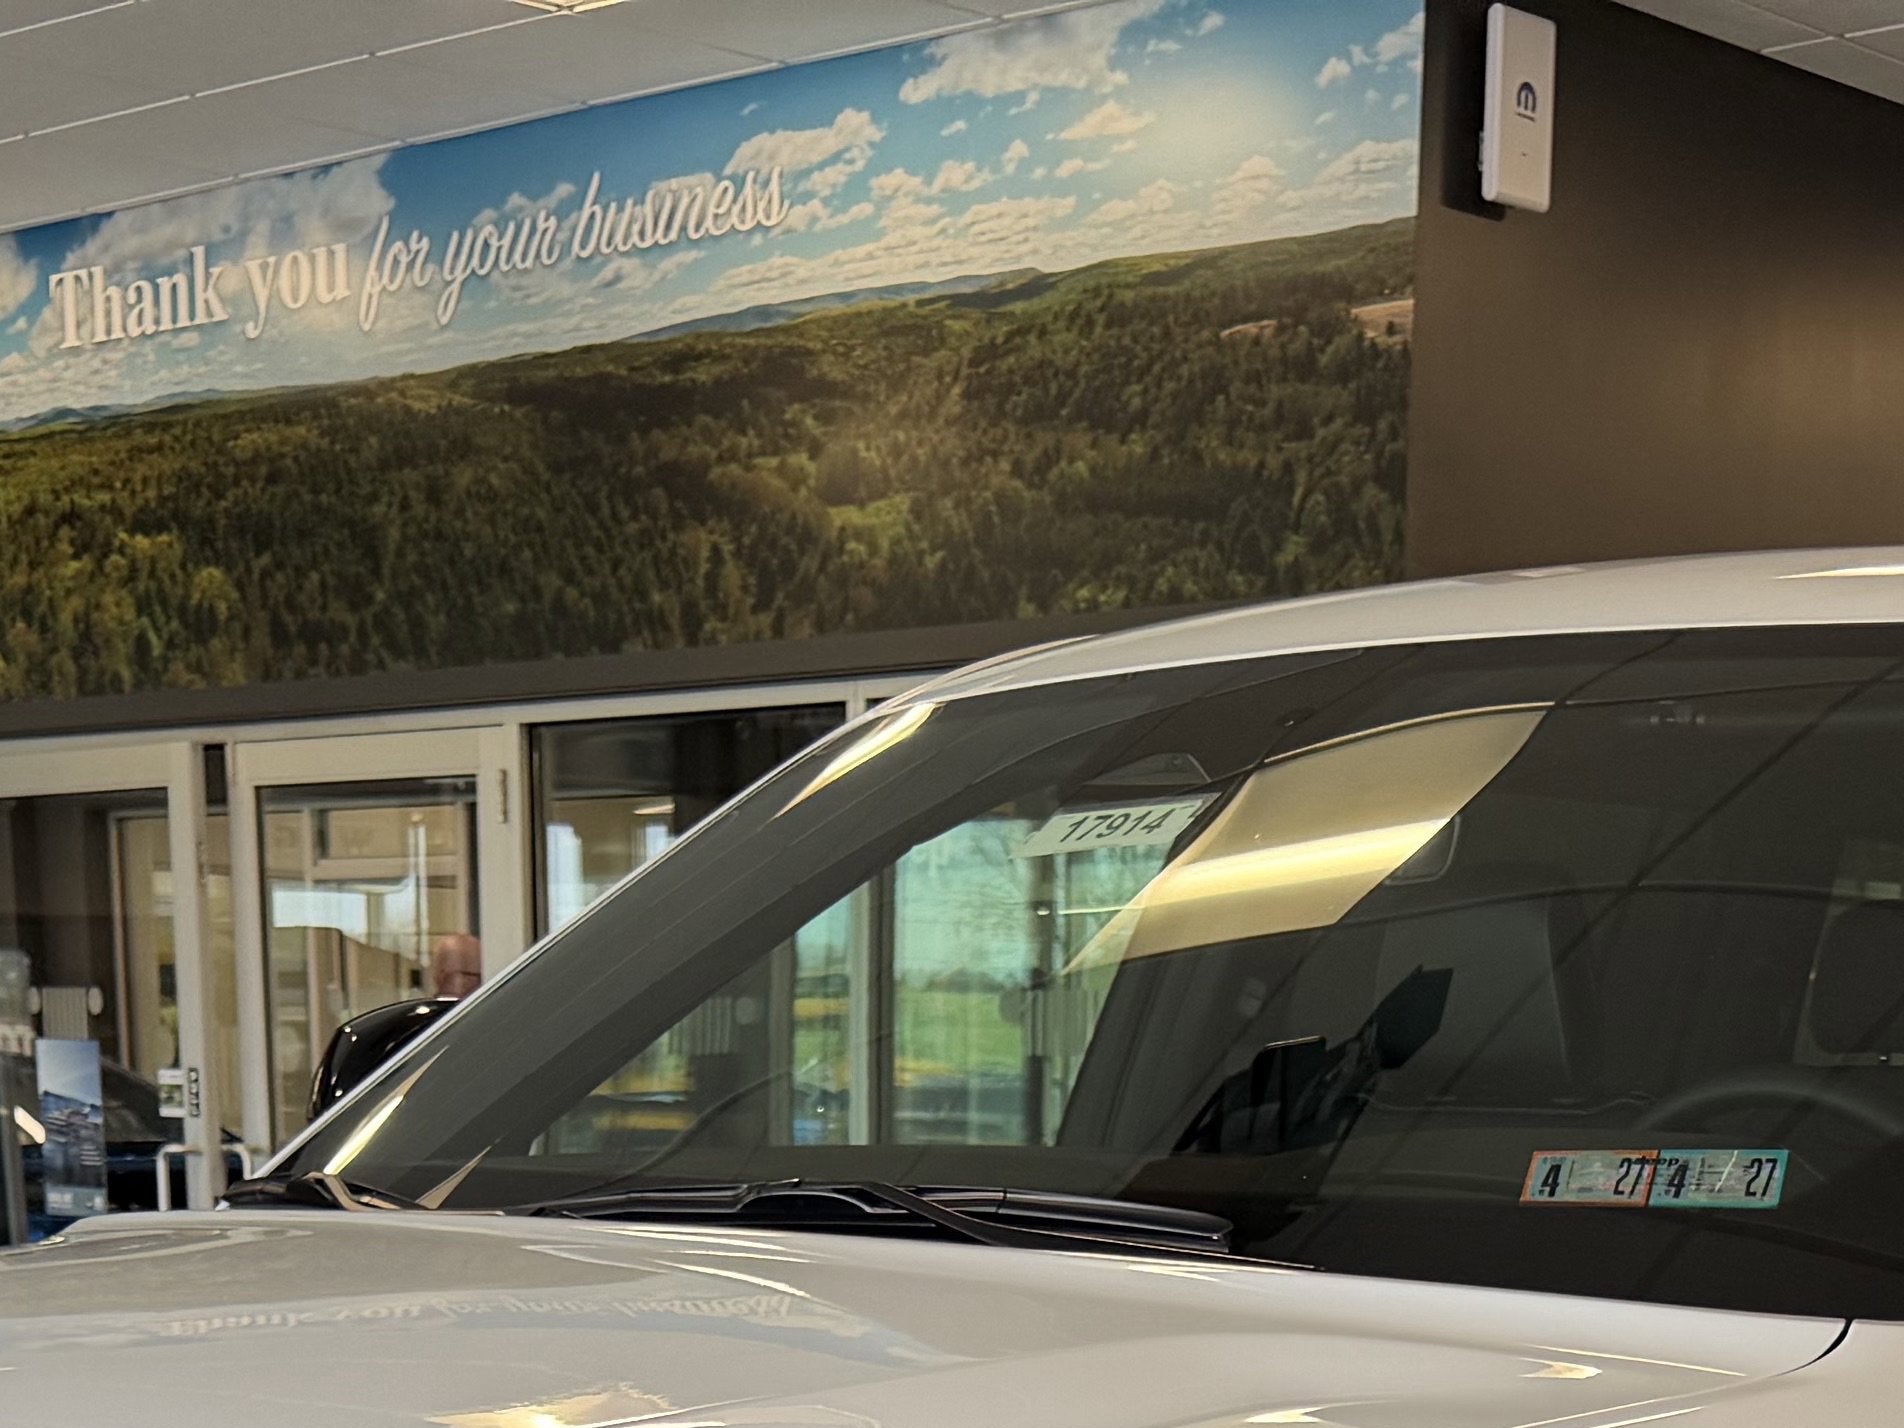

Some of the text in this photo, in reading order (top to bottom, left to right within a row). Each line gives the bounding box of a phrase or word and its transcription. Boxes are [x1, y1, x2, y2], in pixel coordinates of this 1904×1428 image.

[48, 167, 792, 351] Thank you for your business
[1059, 807, 1176, 843] 17914
[1540, 1157, 1648, 1199] 4 27
[1668, 1158, 1778, 1198] 4 27
